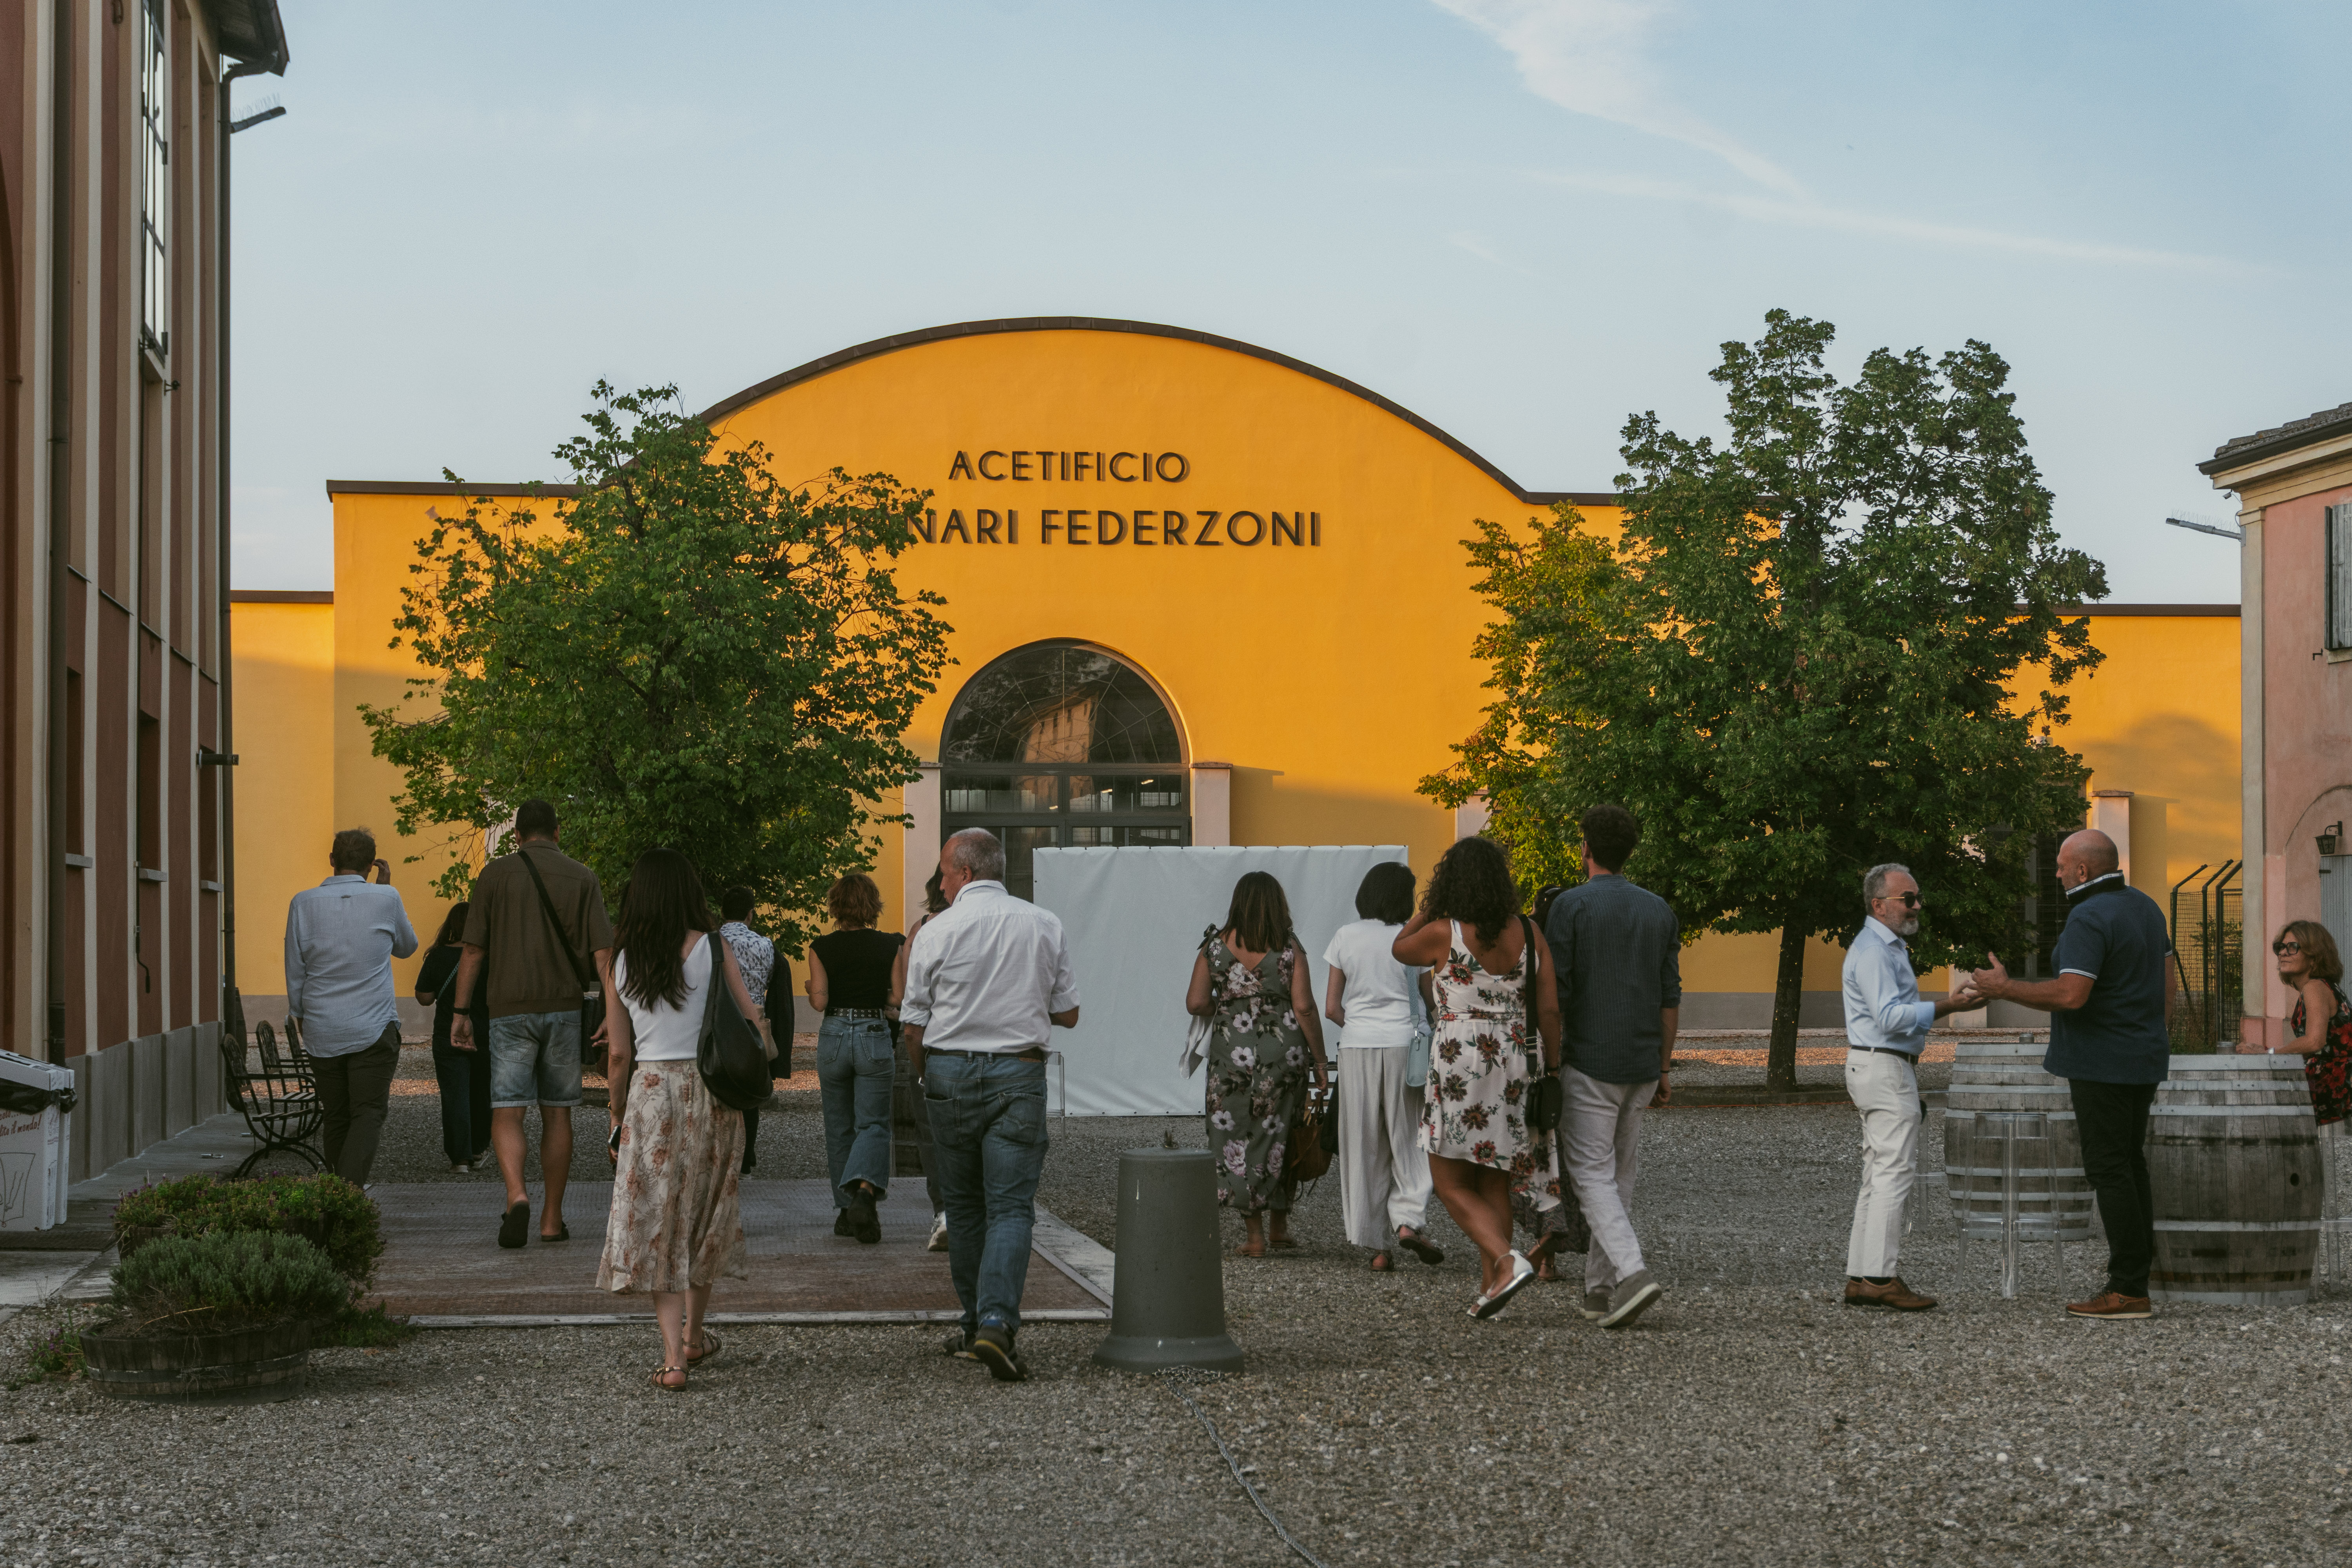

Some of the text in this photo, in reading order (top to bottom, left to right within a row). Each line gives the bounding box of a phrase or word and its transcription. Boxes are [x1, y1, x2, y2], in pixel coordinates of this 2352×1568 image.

[948, 450, 1185, 482] ACETIFICIO
[817, 509, 1316, 546] NARI FEDERZONI
[11, 1120, 17, 1135] il
[17, 1113, 42, 1133] mondo!
